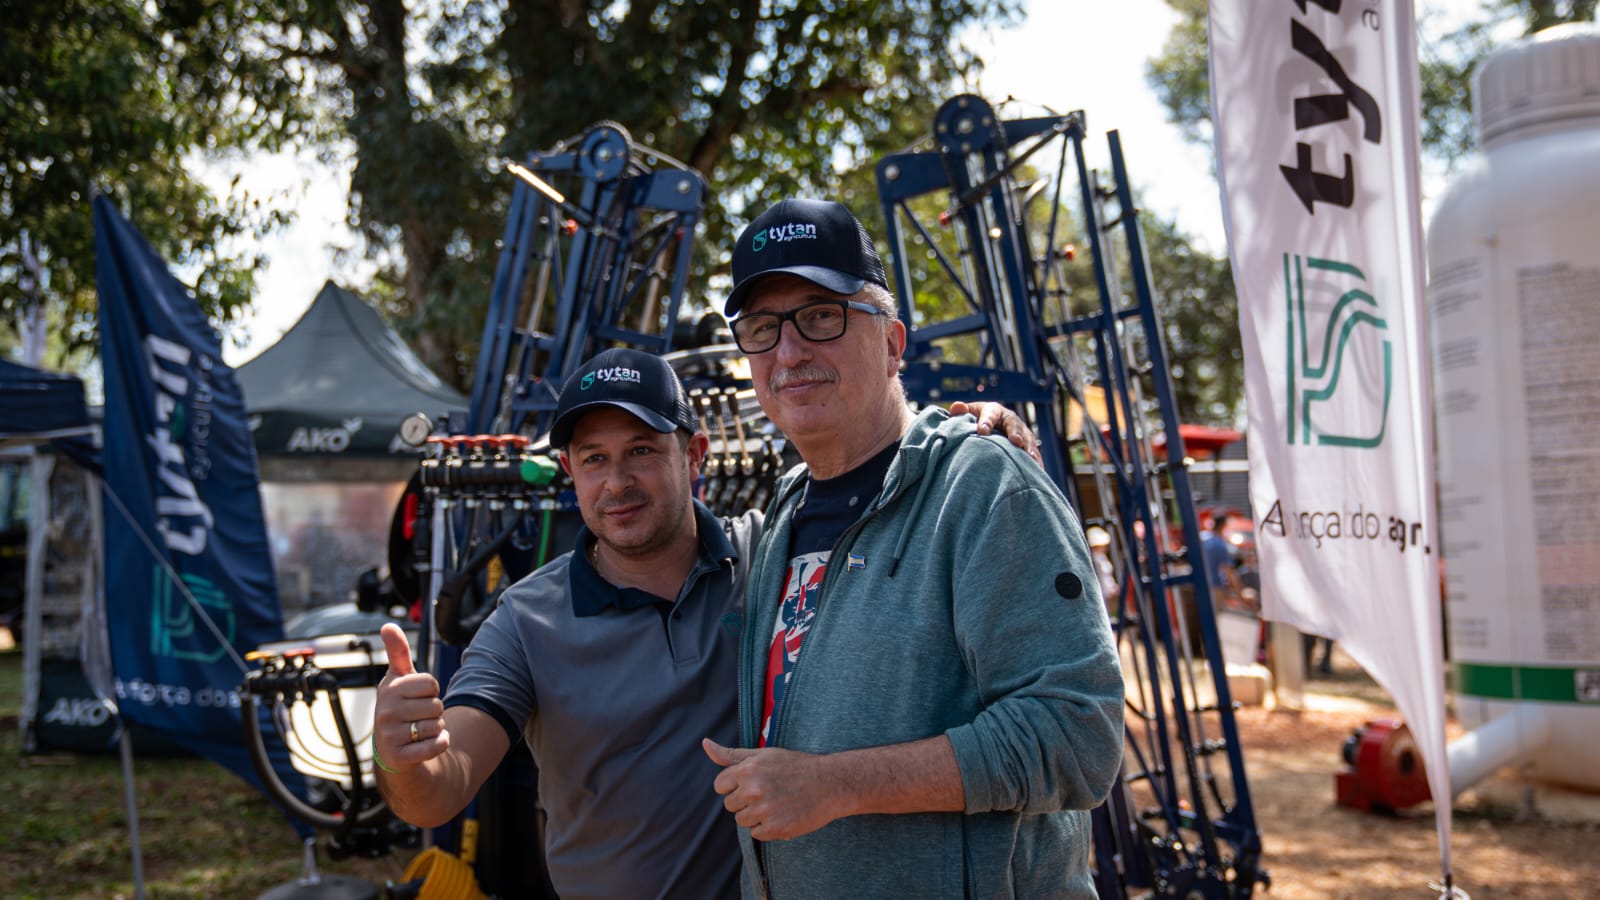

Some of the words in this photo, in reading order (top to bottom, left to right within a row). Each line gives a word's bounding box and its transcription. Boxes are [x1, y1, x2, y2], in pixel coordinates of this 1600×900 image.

[769, 222, 817, 242] tytan
[597, 366, 641, 381] tytan
[286, 427, 351, 453] AKO
[44, 698, 110, 726] AKO
